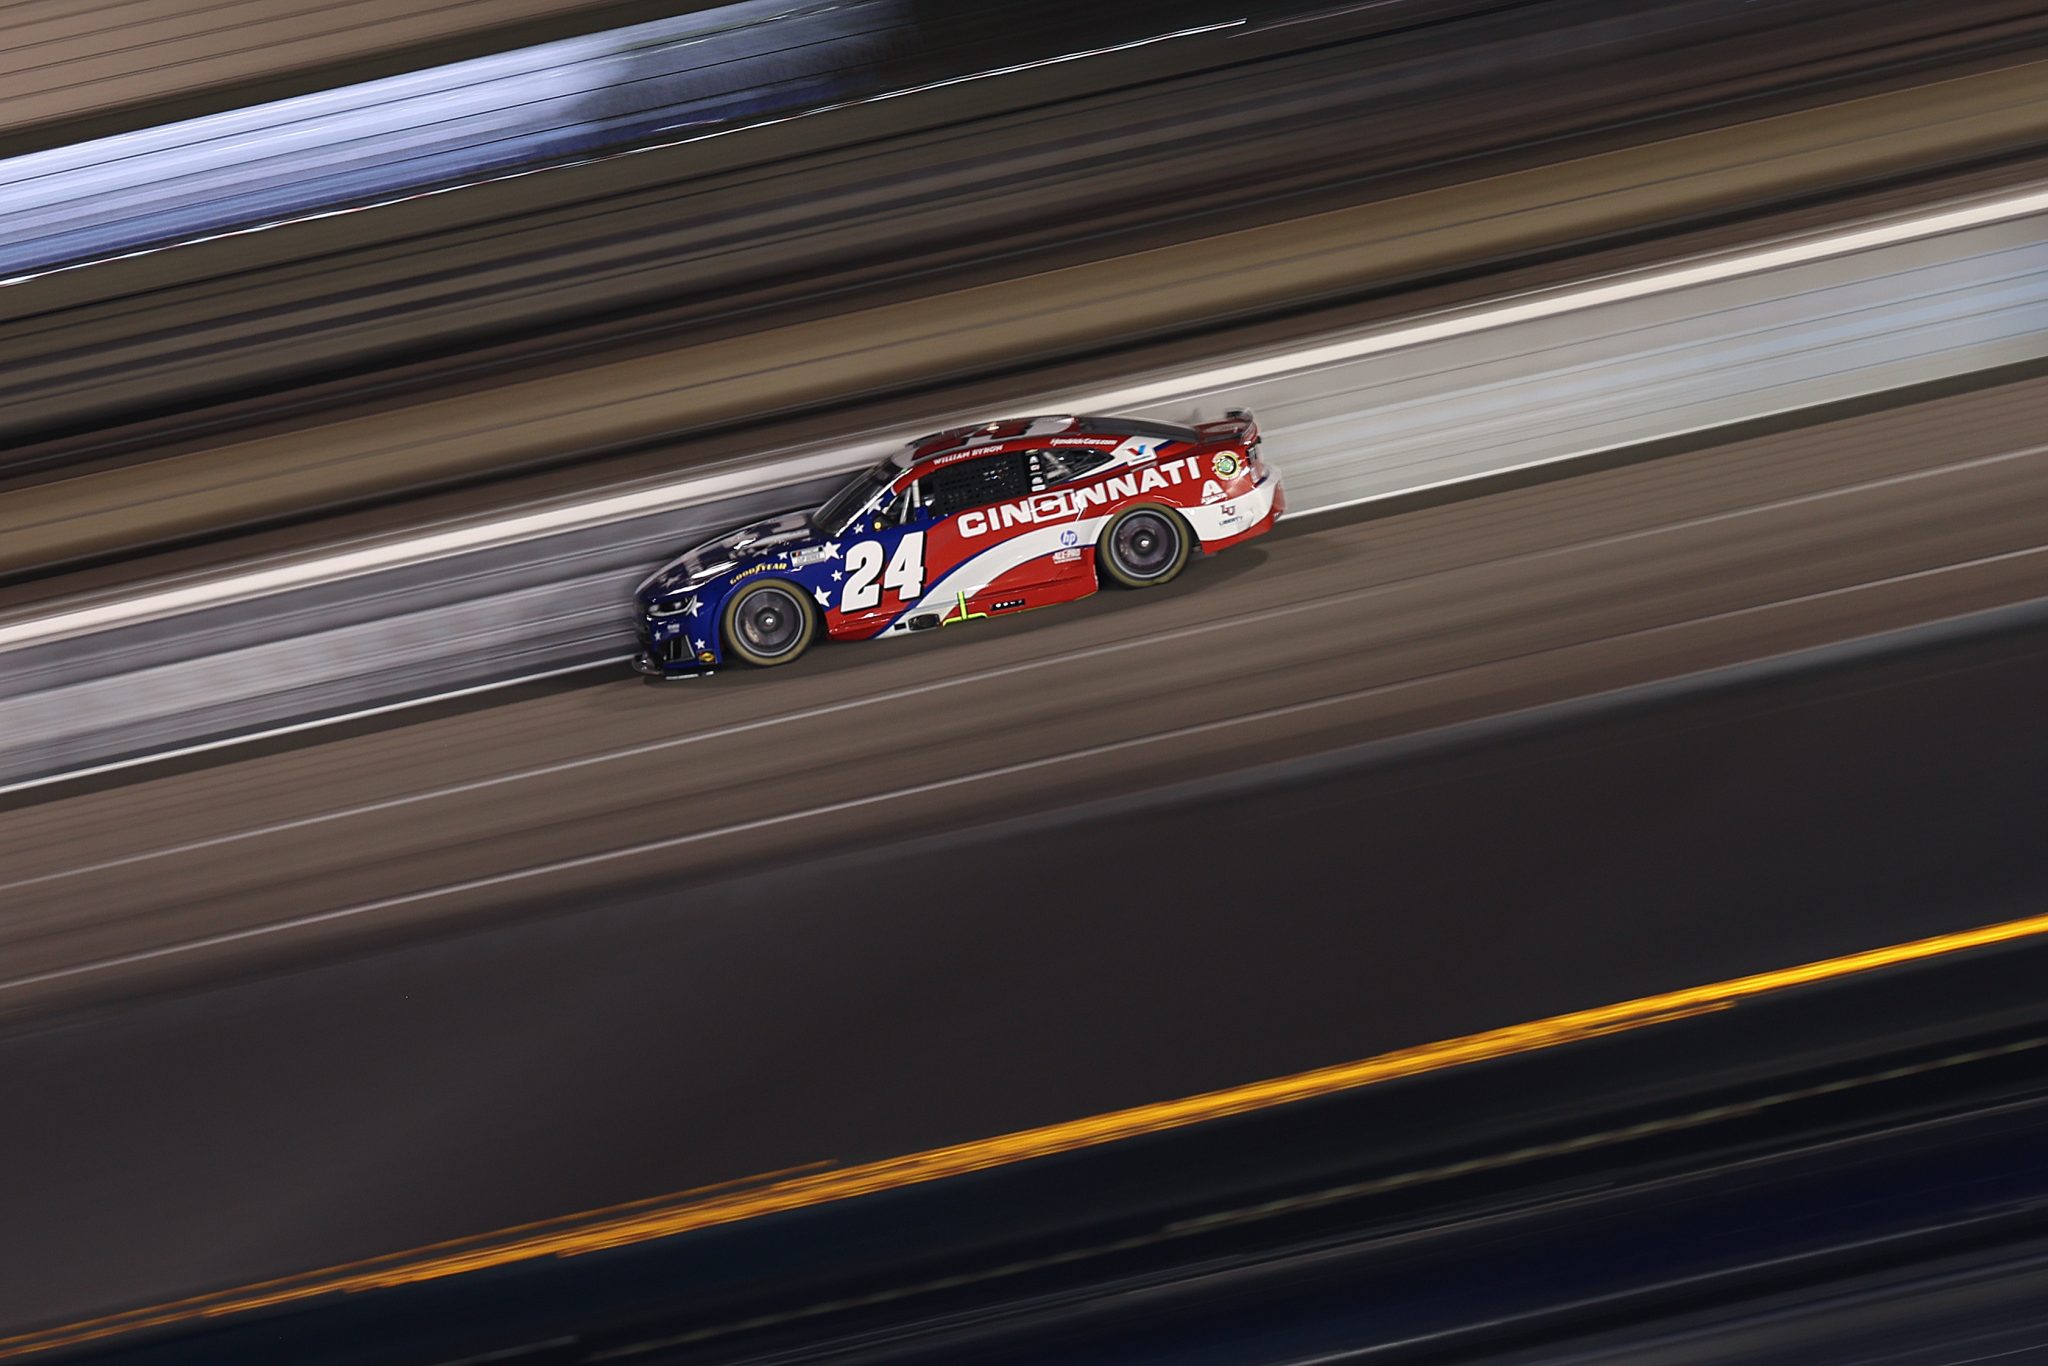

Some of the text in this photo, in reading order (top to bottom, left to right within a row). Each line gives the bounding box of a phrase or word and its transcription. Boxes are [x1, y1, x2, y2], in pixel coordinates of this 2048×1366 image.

[932, 444, 1003, 466] WILLIAM BYRON
[957, 456, 1202, 539] CINCINNATI
[730, 562, 788, 585] GOODYEAR
[840, 531, 926, 613] 24
